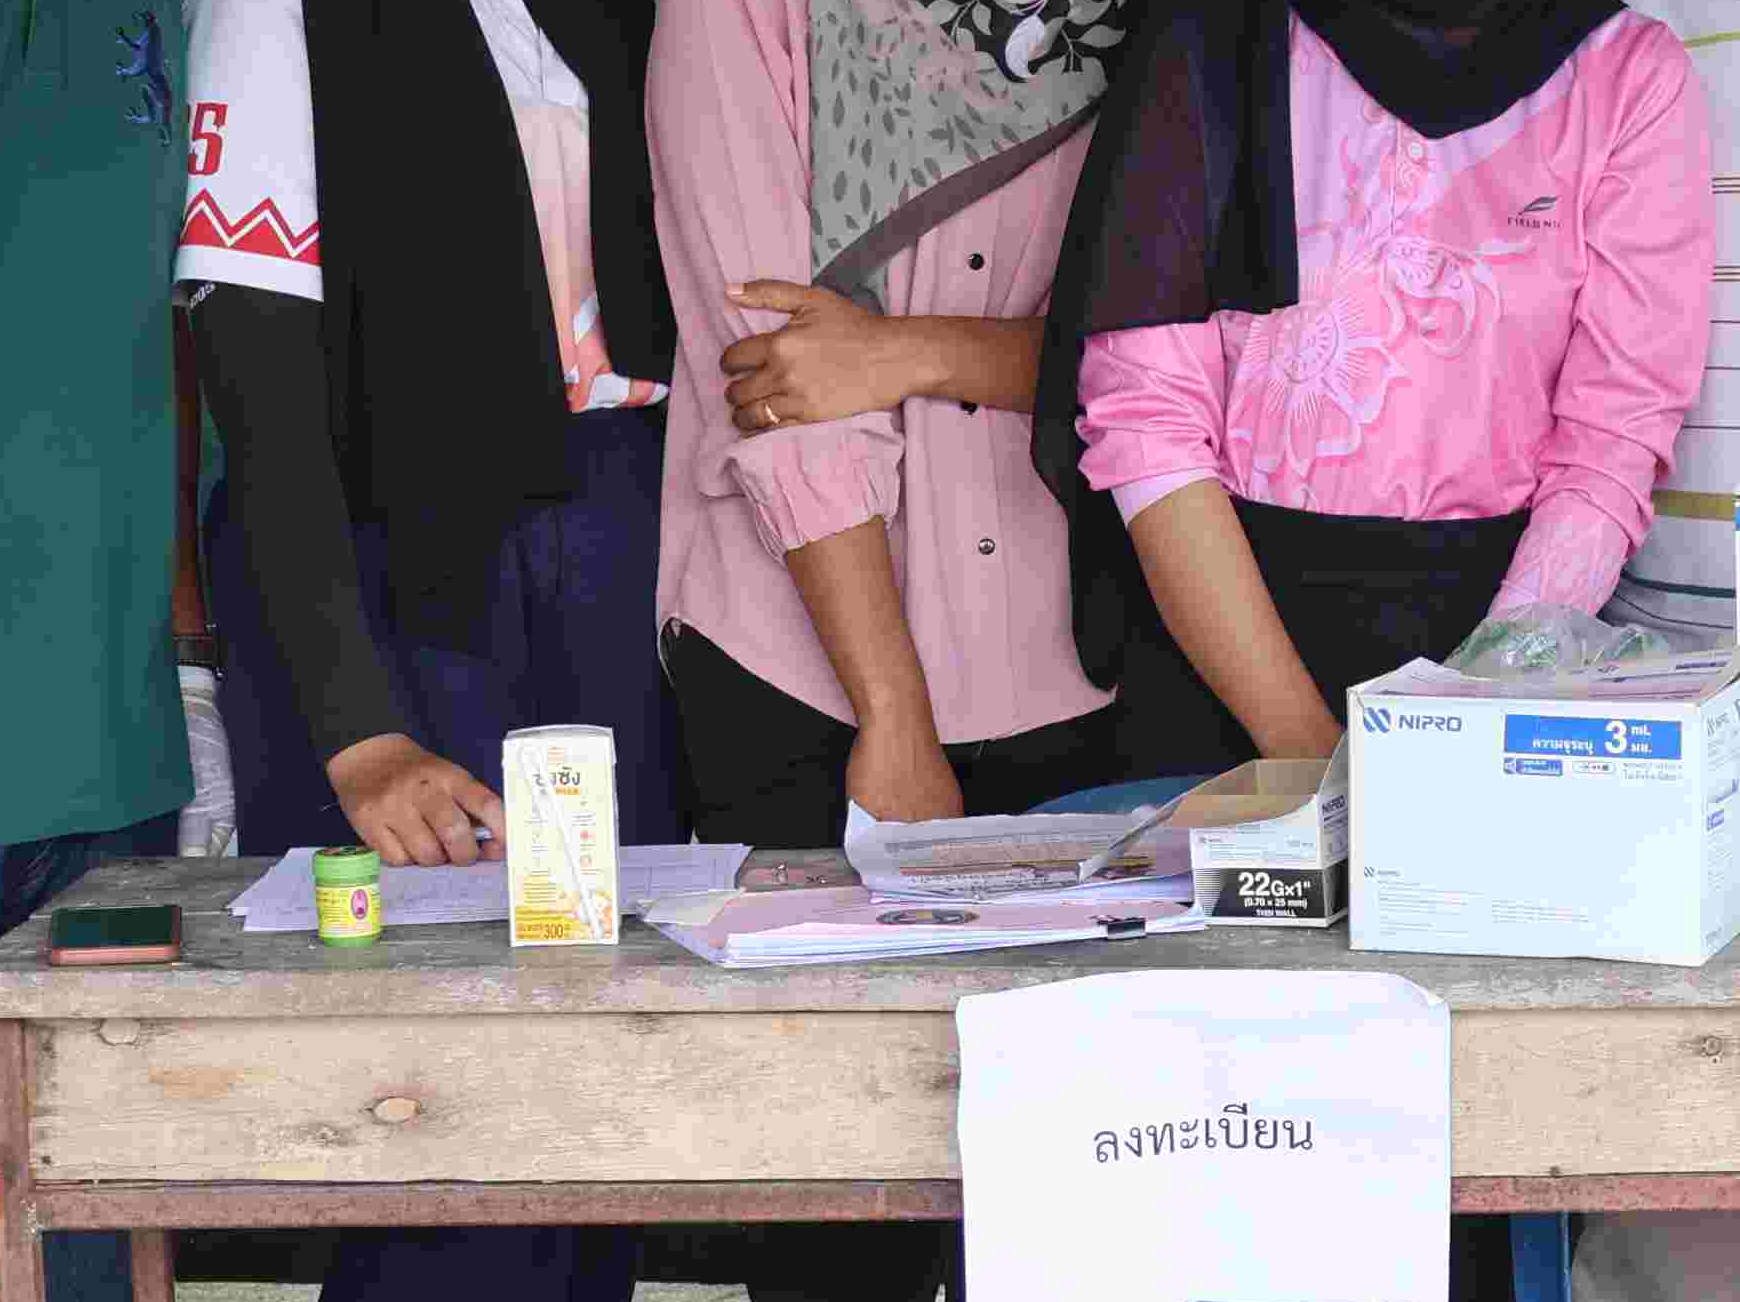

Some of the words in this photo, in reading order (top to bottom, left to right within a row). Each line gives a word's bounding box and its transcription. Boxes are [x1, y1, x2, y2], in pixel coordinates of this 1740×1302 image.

[1398, 713, 1463, 733] NIPRO
[1603, 719, 1629, 755] 3
[1237, 871, 1312, 897] 22Gx1"
